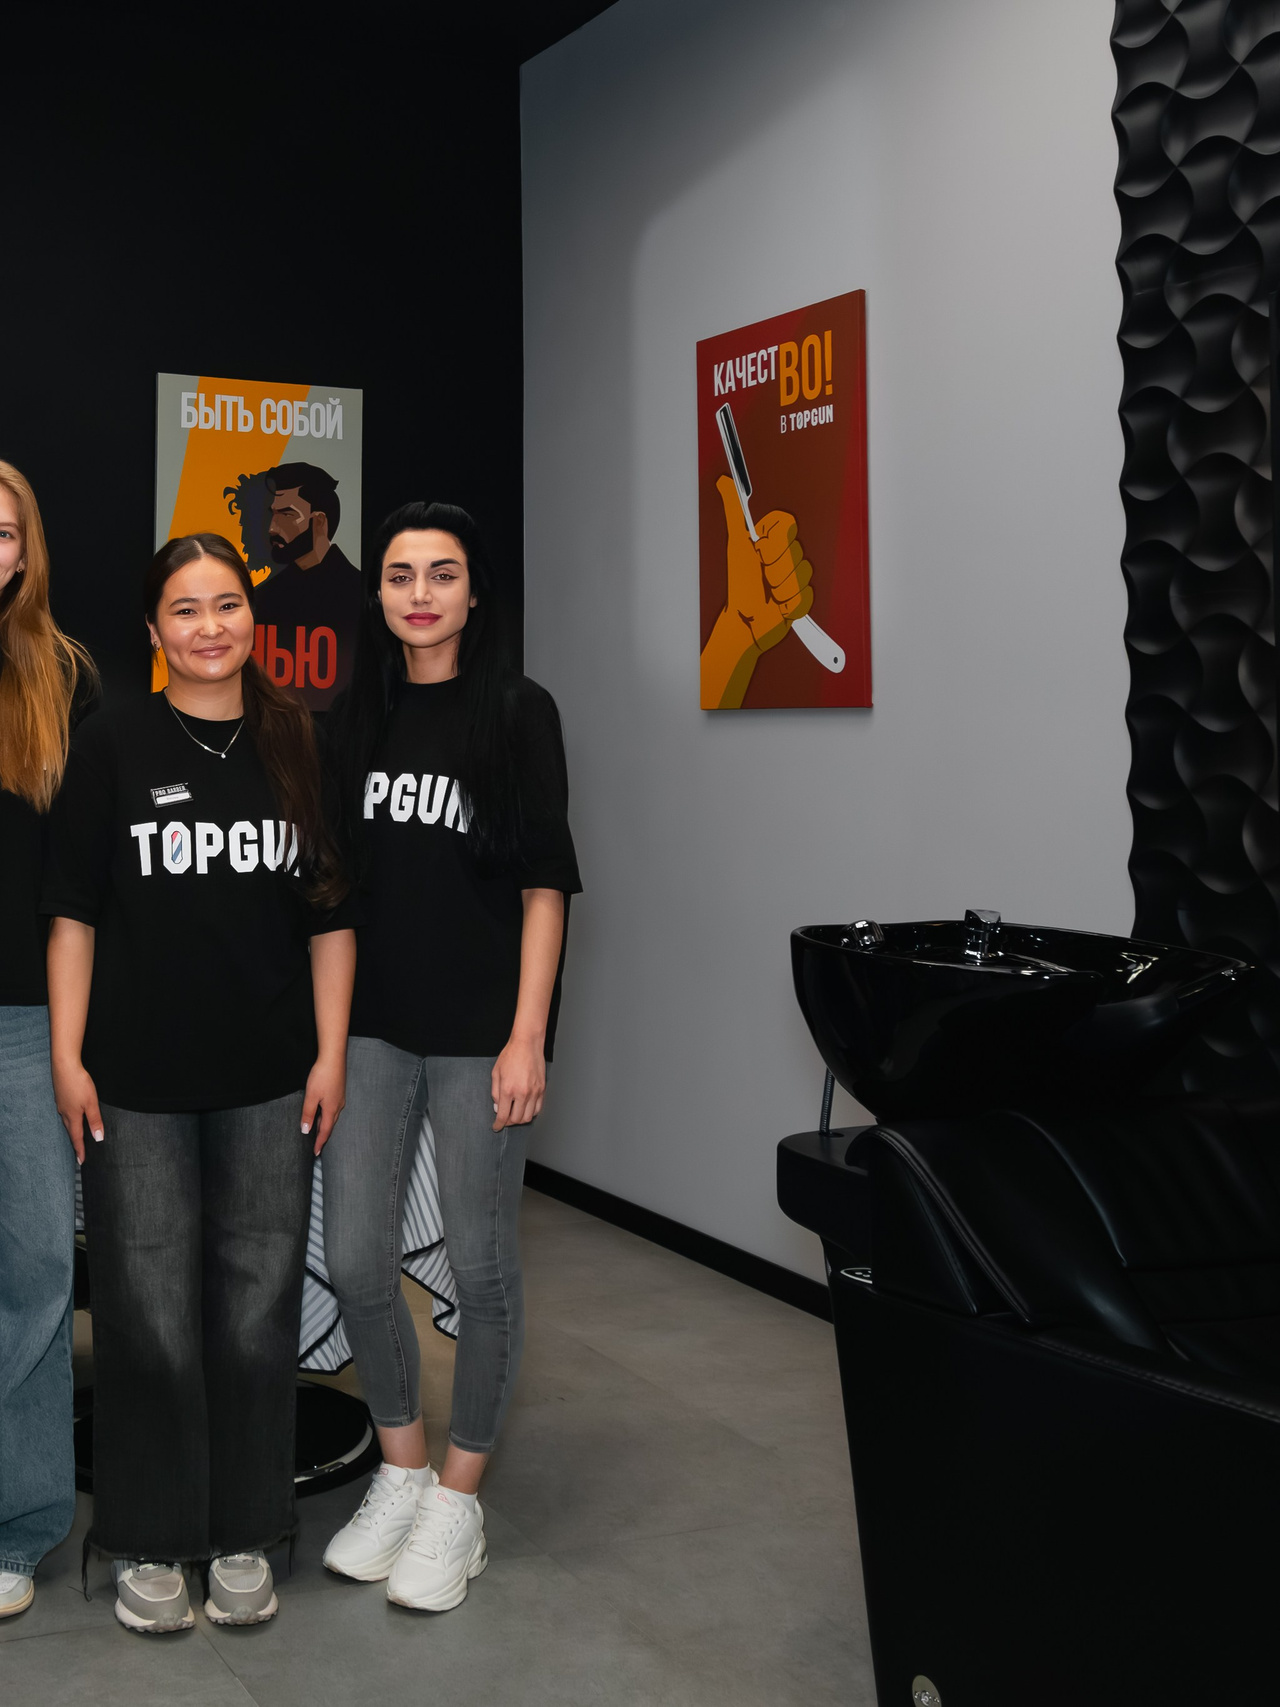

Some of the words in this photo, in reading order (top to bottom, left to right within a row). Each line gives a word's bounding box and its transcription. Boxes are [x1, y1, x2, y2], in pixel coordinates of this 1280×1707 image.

[714, 330, 833, 407] КАЧЕСТВО!
[181, 391, 254, 433] БЫТЬ
[260, 397, 343, 440] СОБОЙ
[780, 415, 787, 434] В
[789, 404, 834, 431] TOPGUN
